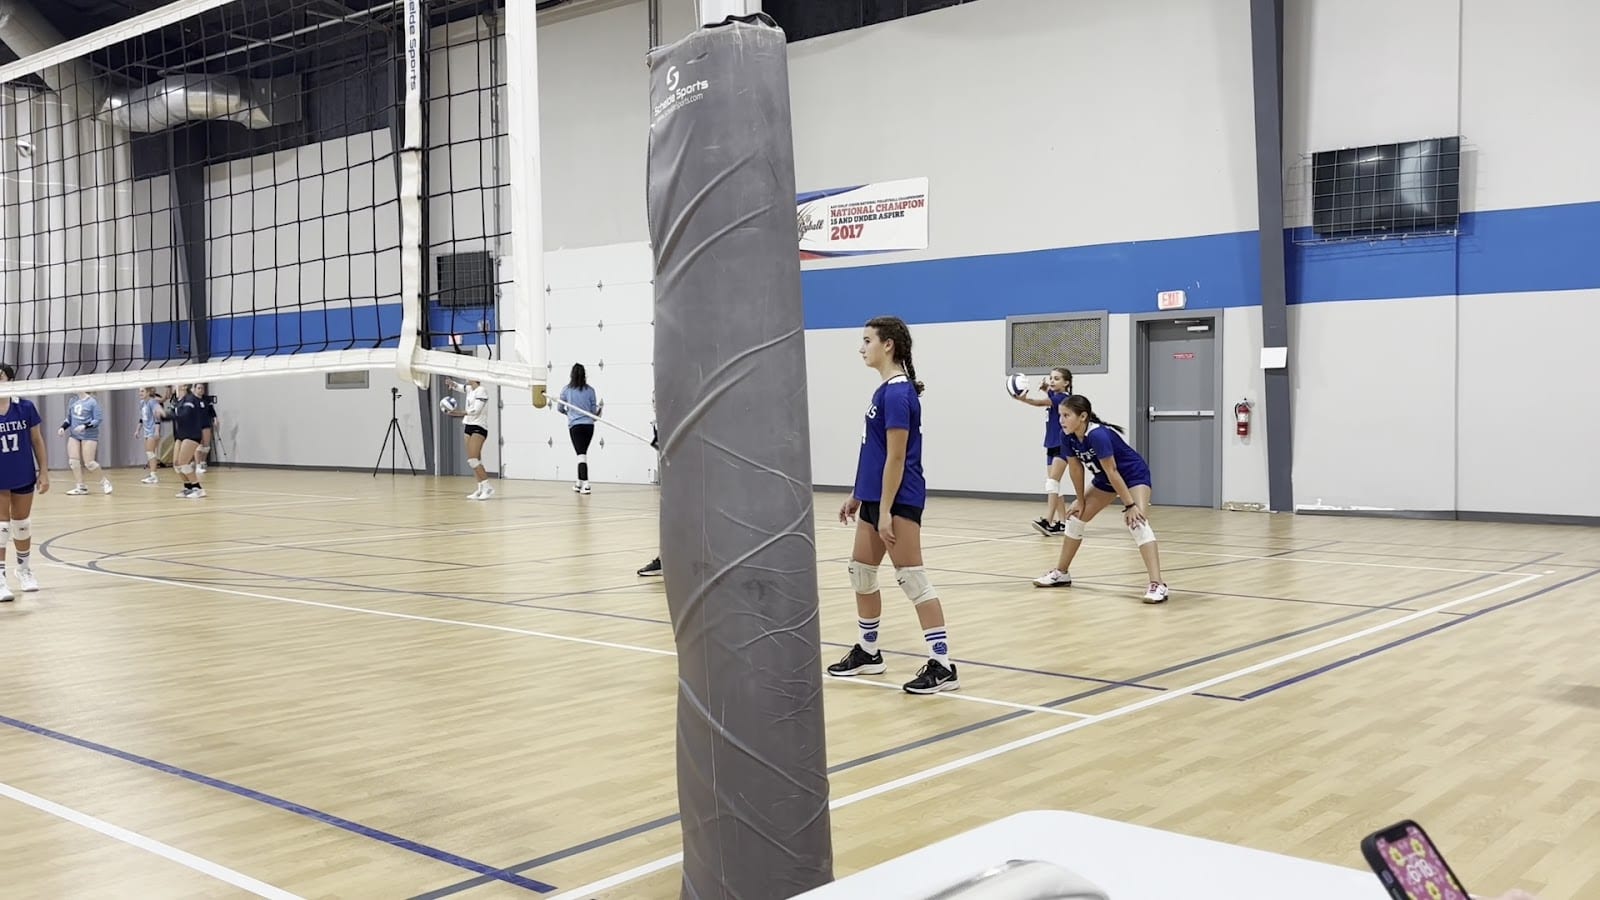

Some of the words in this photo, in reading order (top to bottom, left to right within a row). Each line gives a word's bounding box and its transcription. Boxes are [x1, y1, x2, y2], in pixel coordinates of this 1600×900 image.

[408, 38, 417, 91] Sports
[676, 80, 709, 100] Sports
[830, 205, 874, 218] NATIONAL
[875, 199, 925, 212] CHAMPION
[839, 216, 853, 225] AND
[854, 213, 878, 223] UNDER
[878, 211, 905, 220] ASPIRE
[831, 224, 864, 240] 2017
[1162, 292, 1180, 307] EXIT
[0, 420, 27, 433] RITAS
[0, 433, 19, 453] 17
